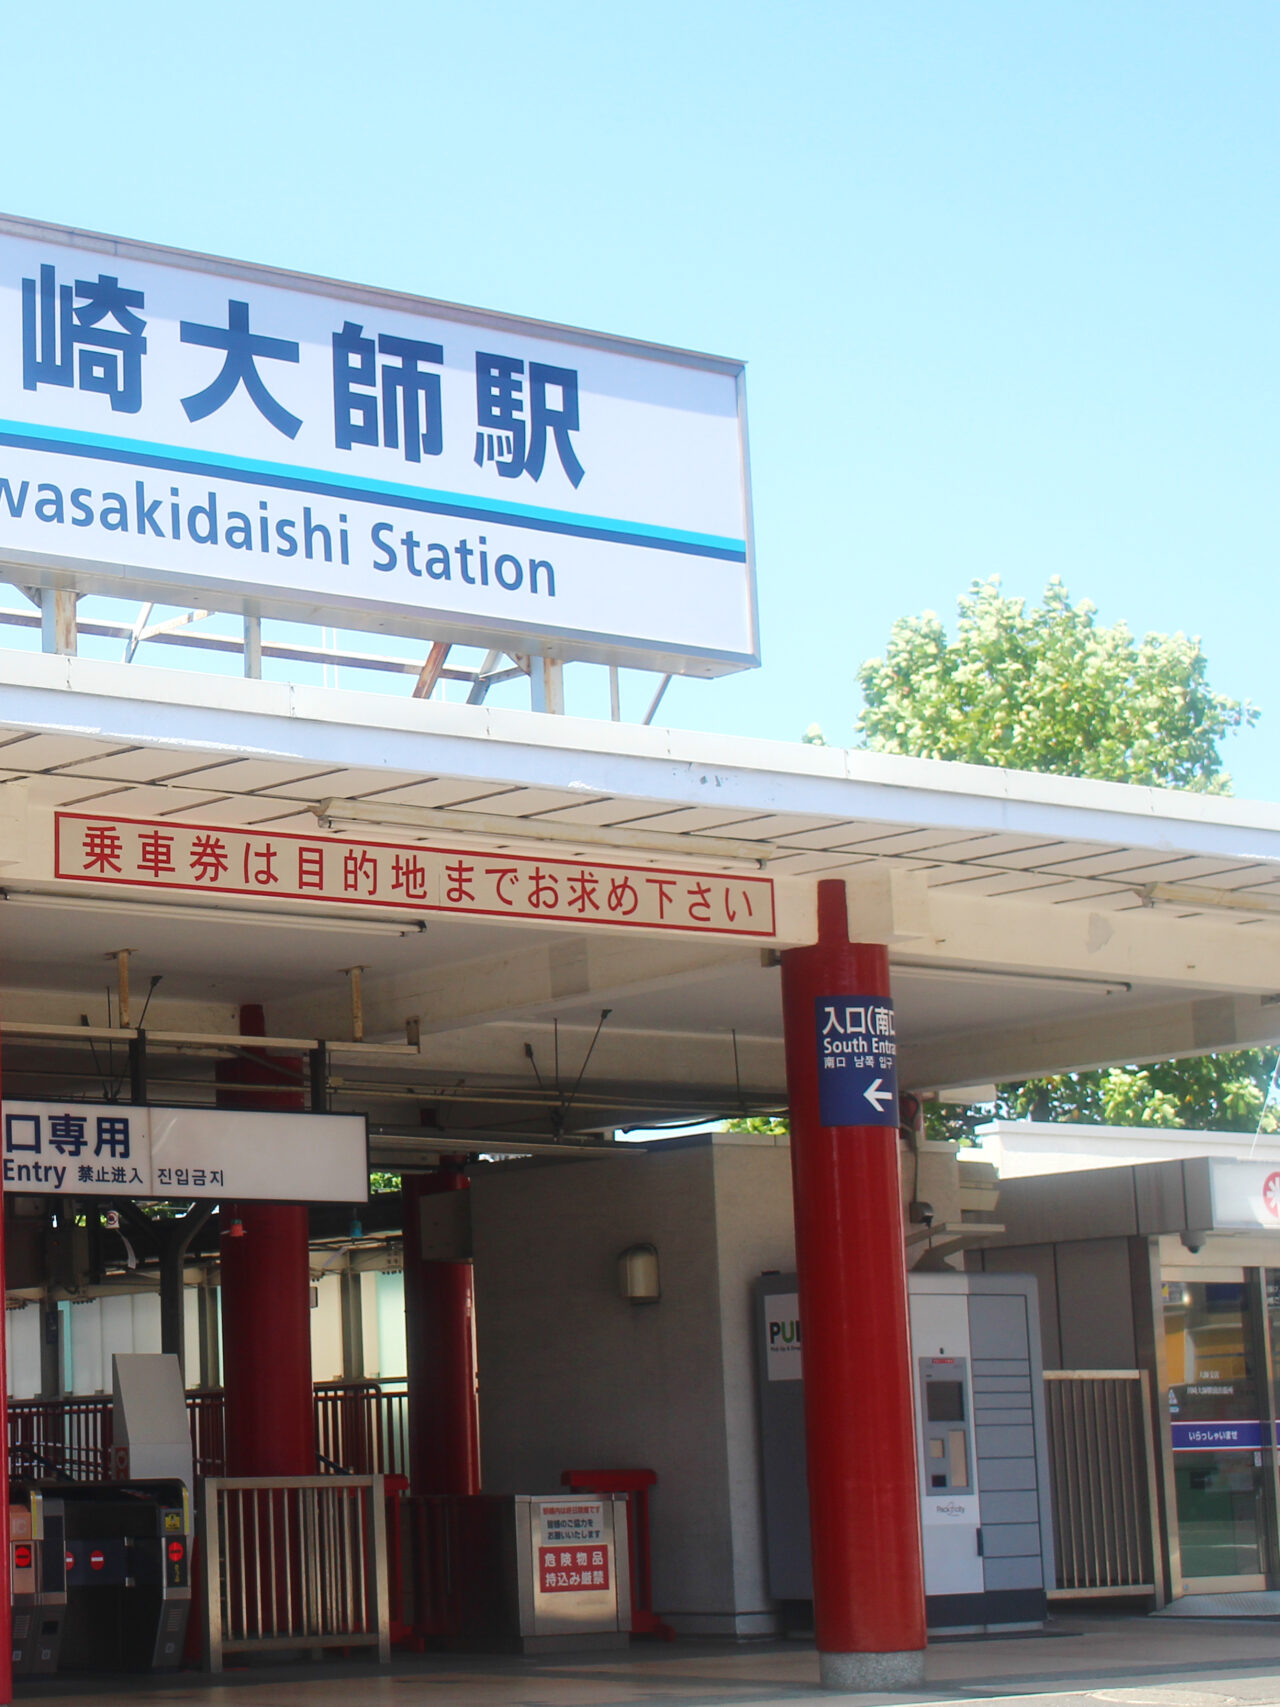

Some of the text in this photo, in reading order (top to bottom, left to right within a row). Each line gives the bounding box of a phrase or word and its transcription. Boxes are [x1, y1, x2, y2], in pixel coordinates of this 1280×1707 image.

[373, 521, 557, 598] Station
[82, 825, 754, 923] 乗車券は目的地までお求め下さい
[824, 1036, 867, 1054] South
[824, 1056, 846, 1069] 南口
[5, 1113, 131, 1158] 口専用
[4, 1159, 67, 1188] Entry
[78, 1165, 144, 1184] 禁止进入
[157, 1167, 224, 1187] 진입금지
[1188, 1431, 1238, 1441] いらっしゃいませ
[547, 1530, 601, 1541] お願いいたします
[544, 1551, 603, 1567] 危険物品
[545, 1571, 604, 1587] 持込み厳禁
